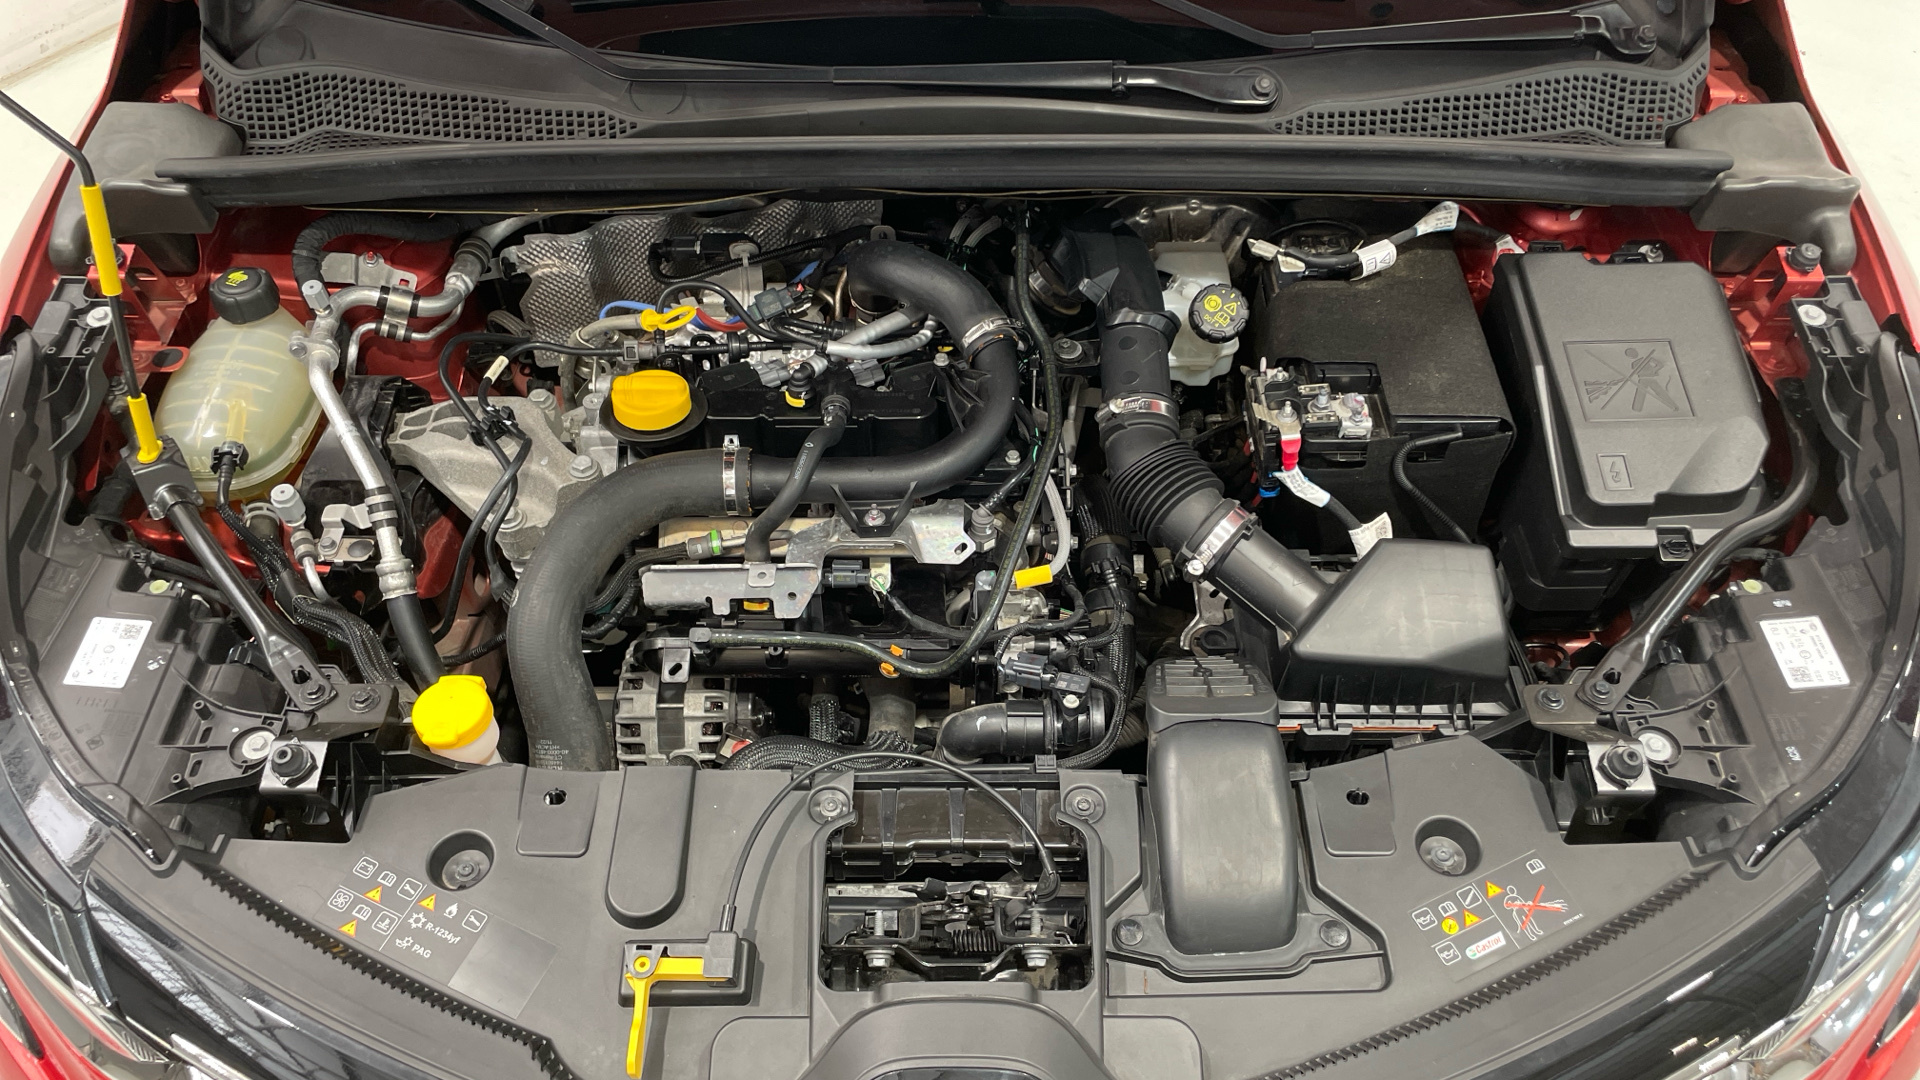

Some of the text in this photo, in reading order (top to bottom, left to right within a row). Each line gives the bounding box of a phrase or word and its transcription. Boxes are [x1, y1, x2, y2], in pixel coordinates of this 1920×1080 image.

[1204, 313, 1216, 323] DOT
[425, 922, 461, 944] R-1234yf
[411, 944, 431, 958] PAG
[1475, 935, 1502, 954] Castrol
